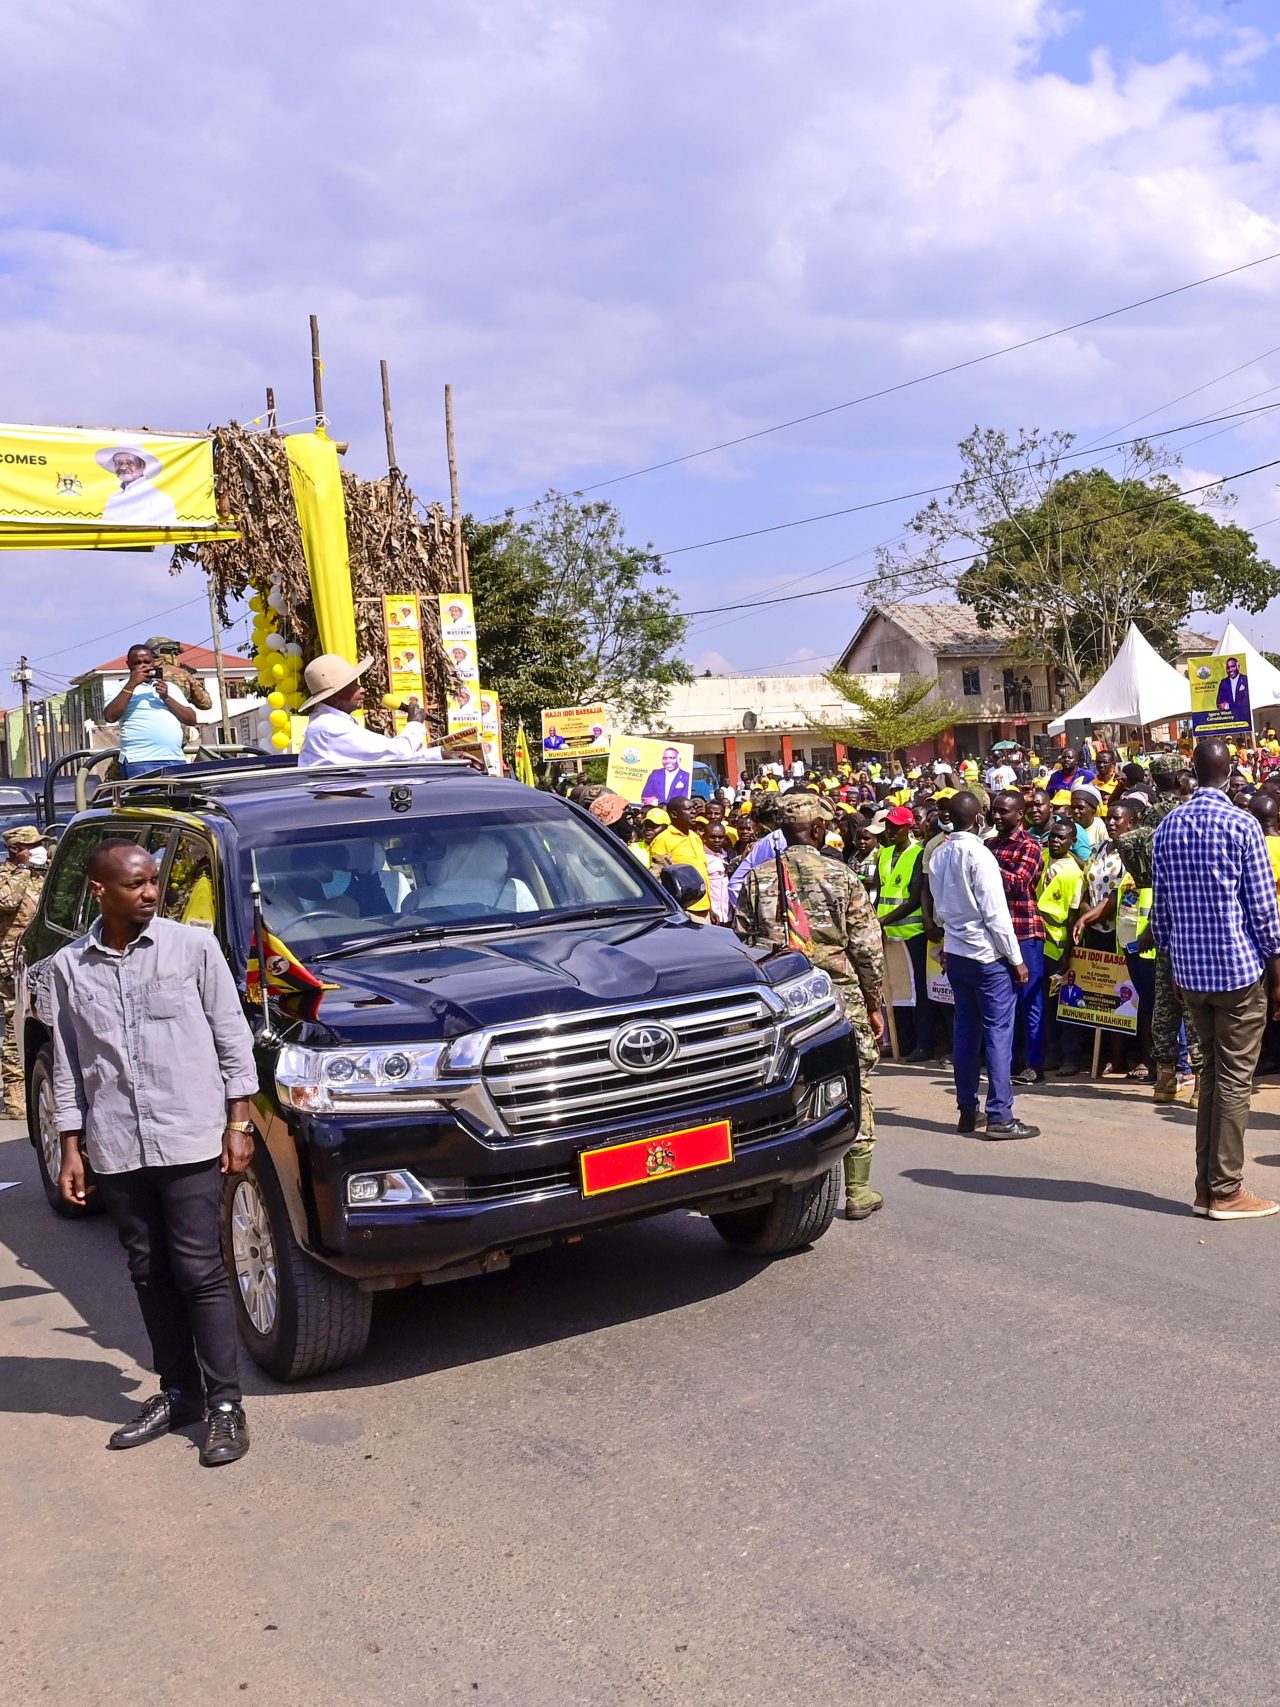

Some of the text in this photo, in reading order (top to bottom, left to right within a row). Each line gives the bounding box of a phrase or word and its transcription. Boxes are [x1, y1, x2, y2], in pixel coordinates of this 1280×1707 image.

[614, 770, 643, 778] BONIFACE
[1072, 949, 1128, 966] AJJI IDDI BASSA
[1062, 1008, 1132, 1028] MUHUMURE NABAHIKIRE
